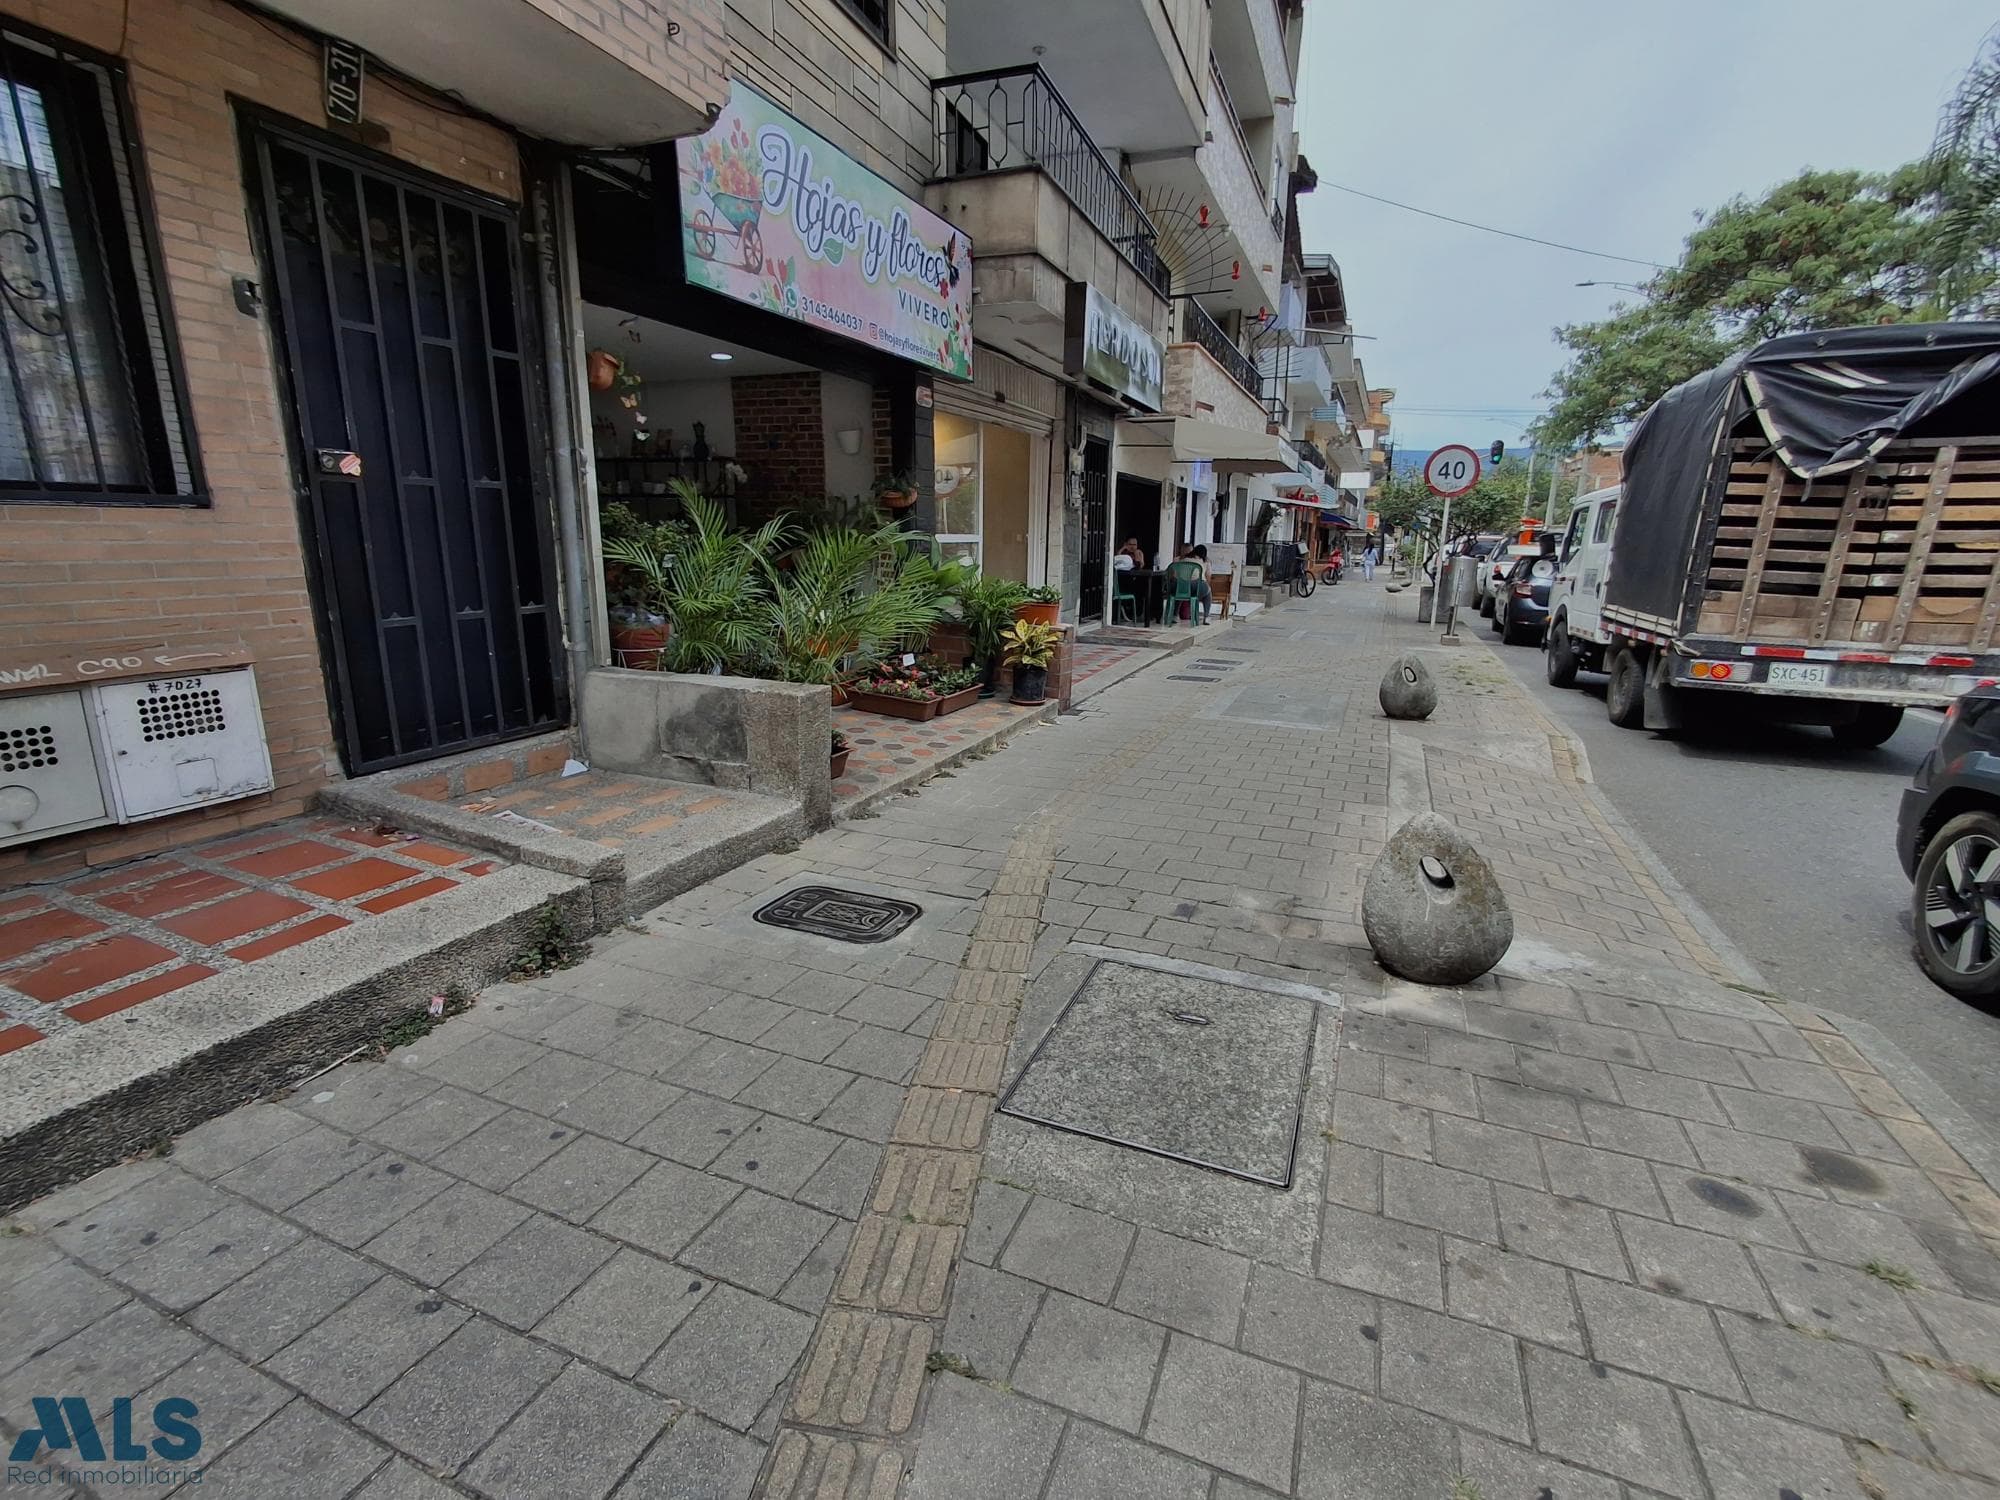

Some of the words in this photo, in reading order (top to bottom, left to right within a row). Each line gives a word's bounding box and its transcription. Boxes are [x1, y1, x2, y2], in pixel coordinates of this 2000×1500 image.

[329, 46, 358, 115] 70-31
[761, 132, 863, 253] Hojas
[864, 217, 888, 277] y
[888, 211, 947, 289] flores
[801, 296, 863, 331] 3143464037
[899, 288, 949, 330] VIVERO
[1437, 460, 1466, 480] 40
